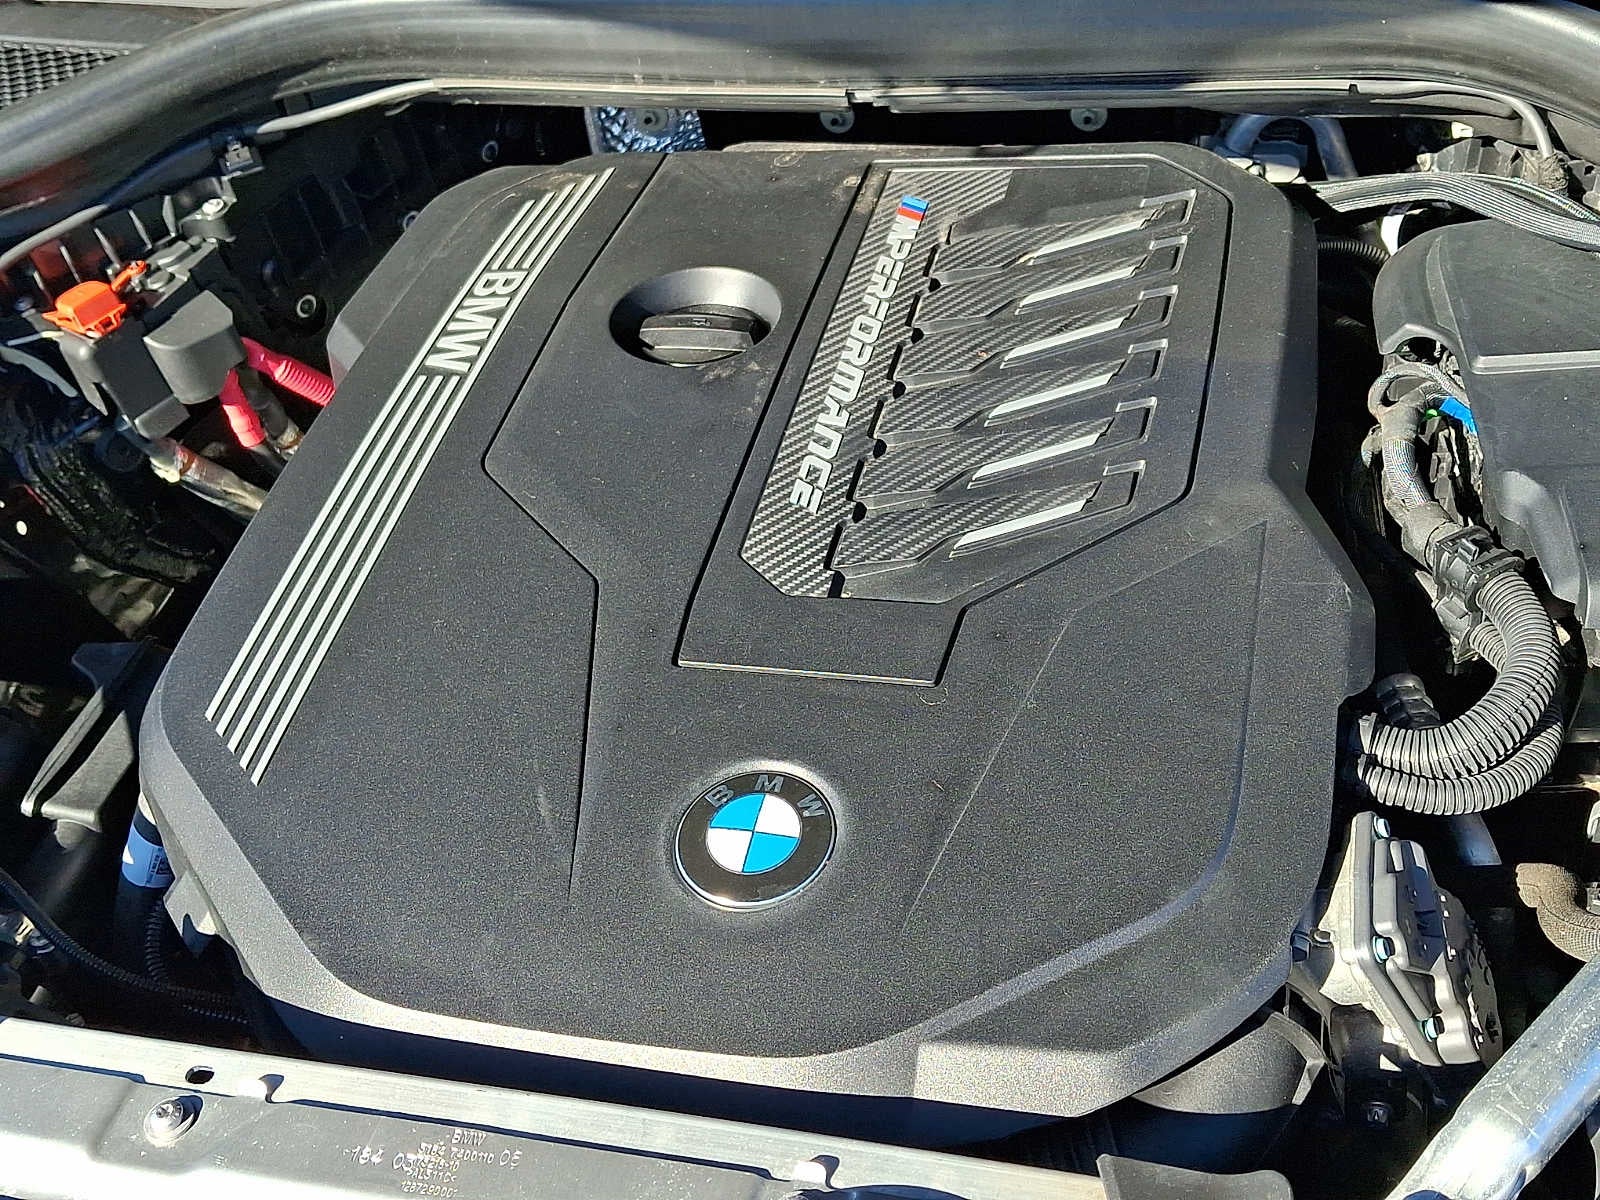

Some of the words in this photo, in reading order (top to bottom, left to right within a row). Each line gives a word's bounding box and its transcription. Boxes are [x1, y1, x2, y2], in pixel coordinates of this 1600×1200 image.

[424, 270, 529, 373] BMW
[789, 233, 914, 514] PERFORMANCE
[704, 774, 826, 818] BMW
[451, 1128, 487, 1146] BMW
